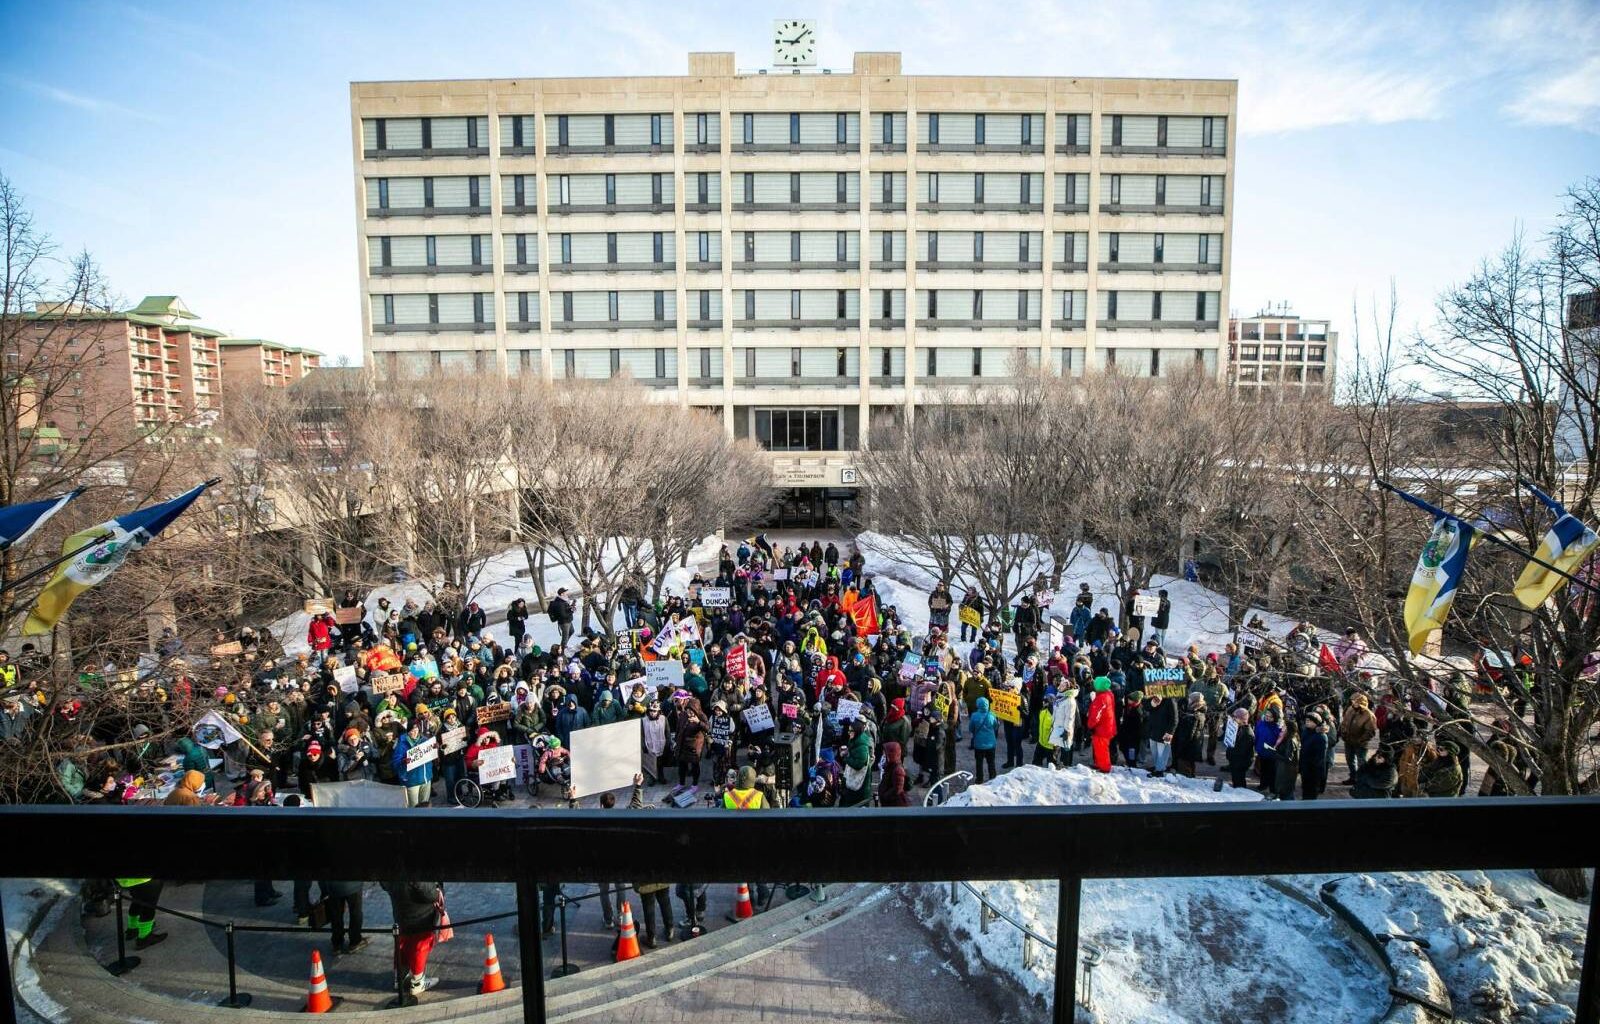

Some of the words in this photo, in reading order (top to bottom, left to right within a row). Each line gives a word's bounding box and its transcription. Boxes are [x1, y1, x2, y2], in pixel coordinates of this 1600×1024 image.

[1144, 668, 1185, 682] PROTEST
[374, 677, 391, 687] NOT
[1166, 684, 1187, 698] RIGHT
[712, 728, 729, 736] RIGHT
[486, 765, 512, 778] NUISANCE
